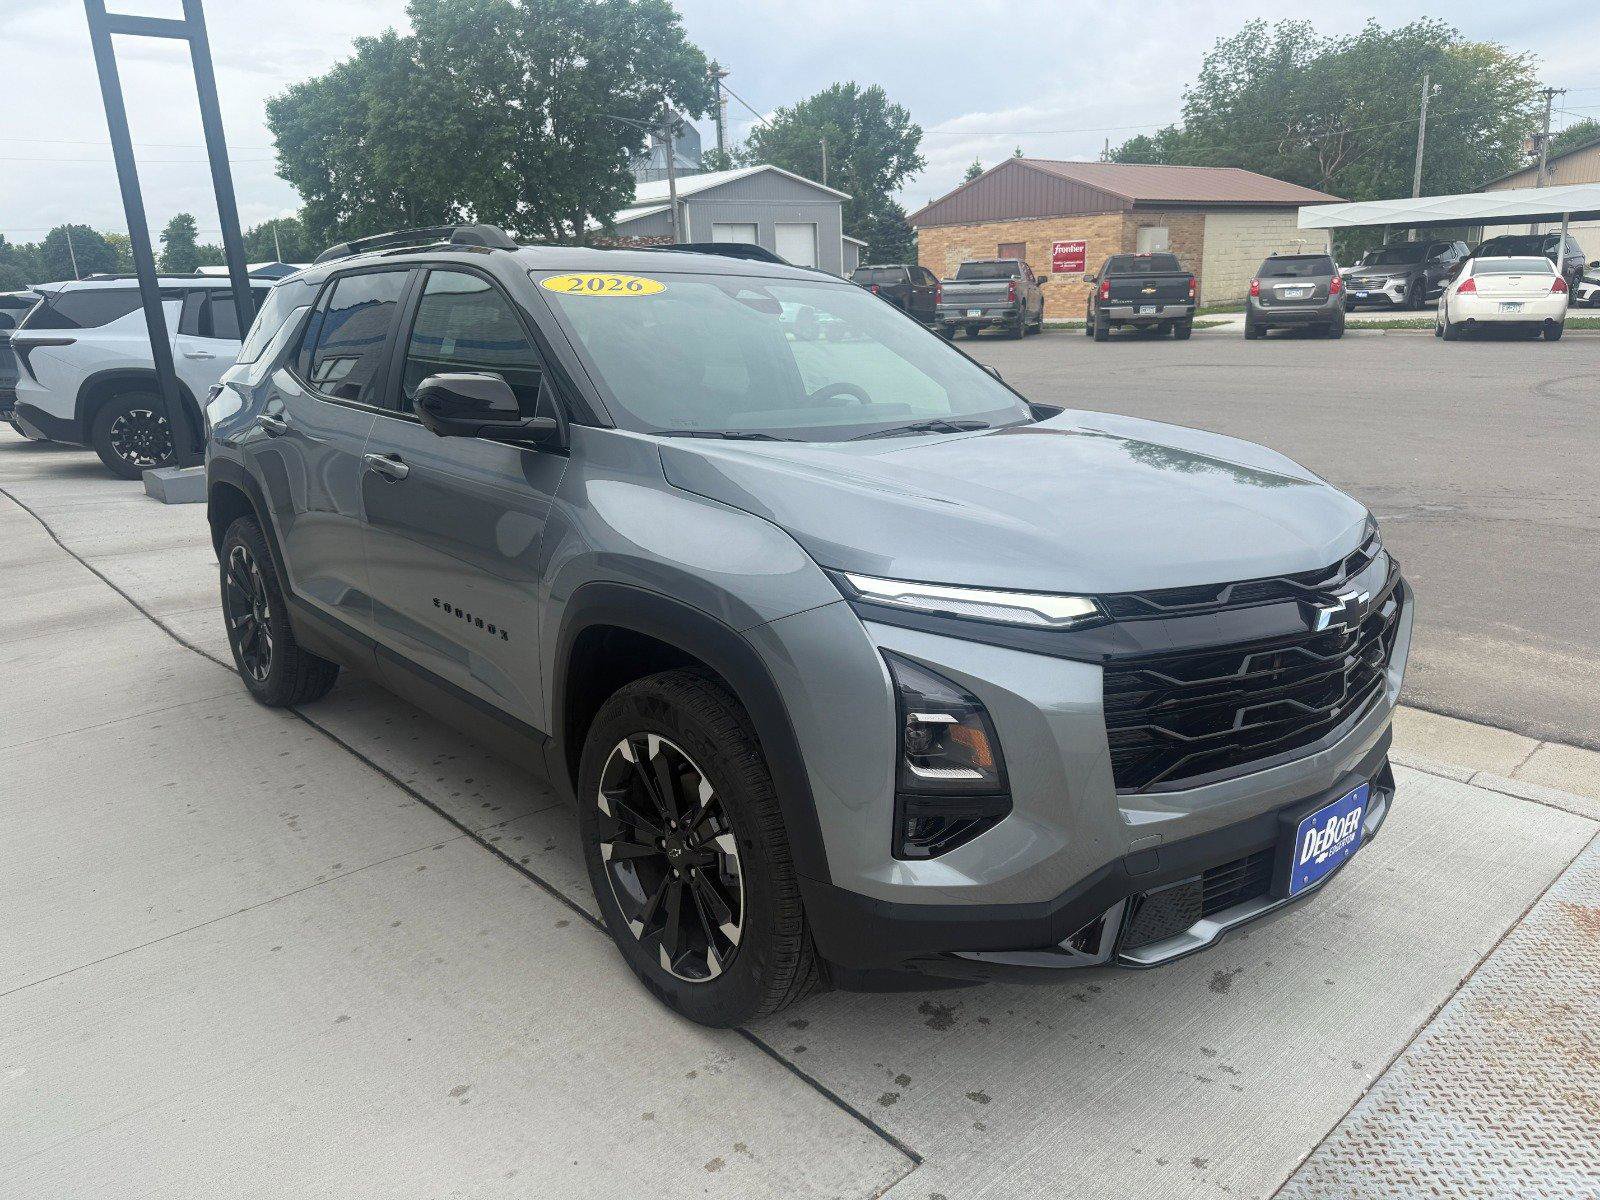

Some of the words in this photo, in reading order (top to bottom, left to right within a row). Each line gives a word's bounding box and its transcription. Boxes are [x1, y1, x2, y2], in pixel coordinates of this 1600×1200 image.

[1053, 244, 1084, 256] frontier
[567, 277, 643, 292] 2026
[432, 597, 509, 641] EQUINOX
